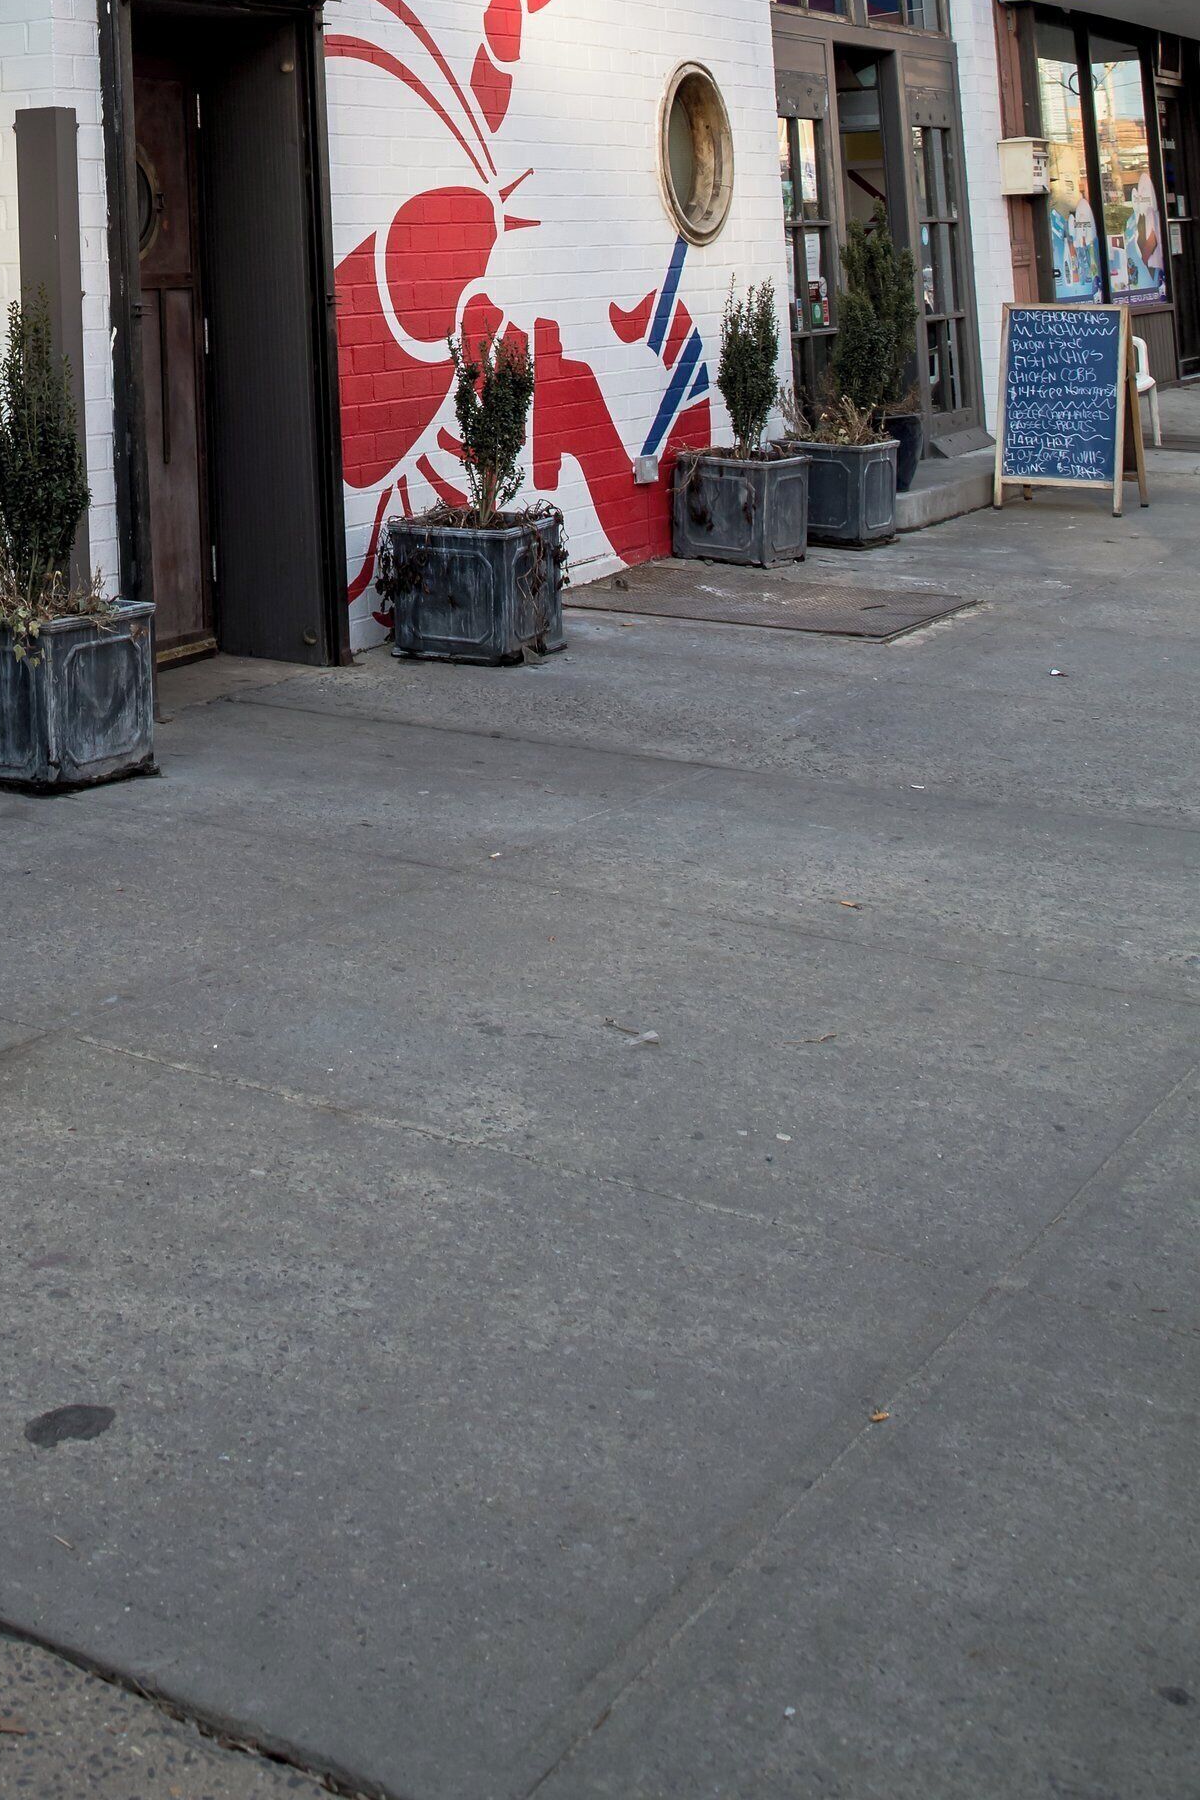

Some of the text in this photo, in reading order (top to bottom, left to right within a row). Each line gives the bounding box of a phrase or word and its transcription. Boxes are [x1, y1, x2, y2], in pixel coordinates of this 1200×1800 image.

[1014, 355, 1045, 370] FISH
[1060, 347, 1103, 364] CHIPS
[1008, 367, 1097, 384] CHICKEN COBB
